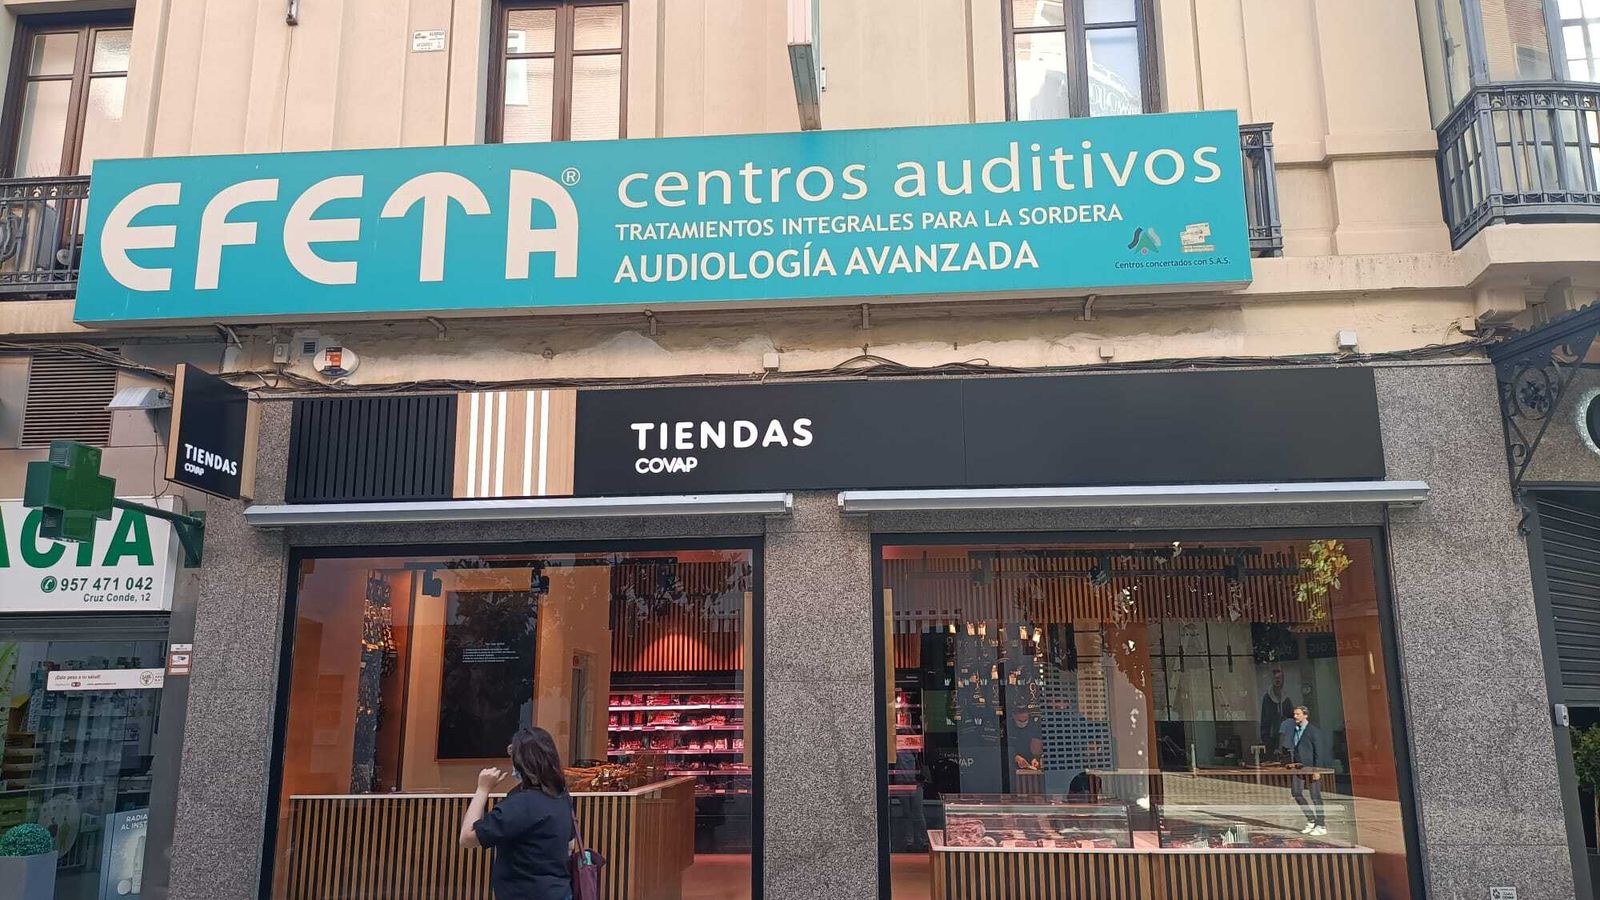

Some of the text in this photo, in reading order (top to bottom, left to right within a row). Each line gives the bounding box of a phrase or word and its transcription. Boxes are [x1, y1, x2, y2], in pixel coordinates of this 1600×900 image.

[617, 140, 1222, 208] centros auditivos
[615, 203, 1123, 241] TRATAMIENTOS INTEGRALES PARA LA SORDERA
[613, 240, 1040, 284] AUDIOLOGÍA AVANZADA
[1115, 261, 1144, 269] Centros
[1145, 258, 1192, 268] concertados
[1209, 257, 1231, 265] S.A.S.
[630, 417, 813, 451] TIENDAS
[184, 443, 238, 476] TIENDAS
[634, 456, 698, 474] COVAP
[60, 576, 153, 592] 957 471 042
[83, 592, 151, 603] Cruz Conde, 12
